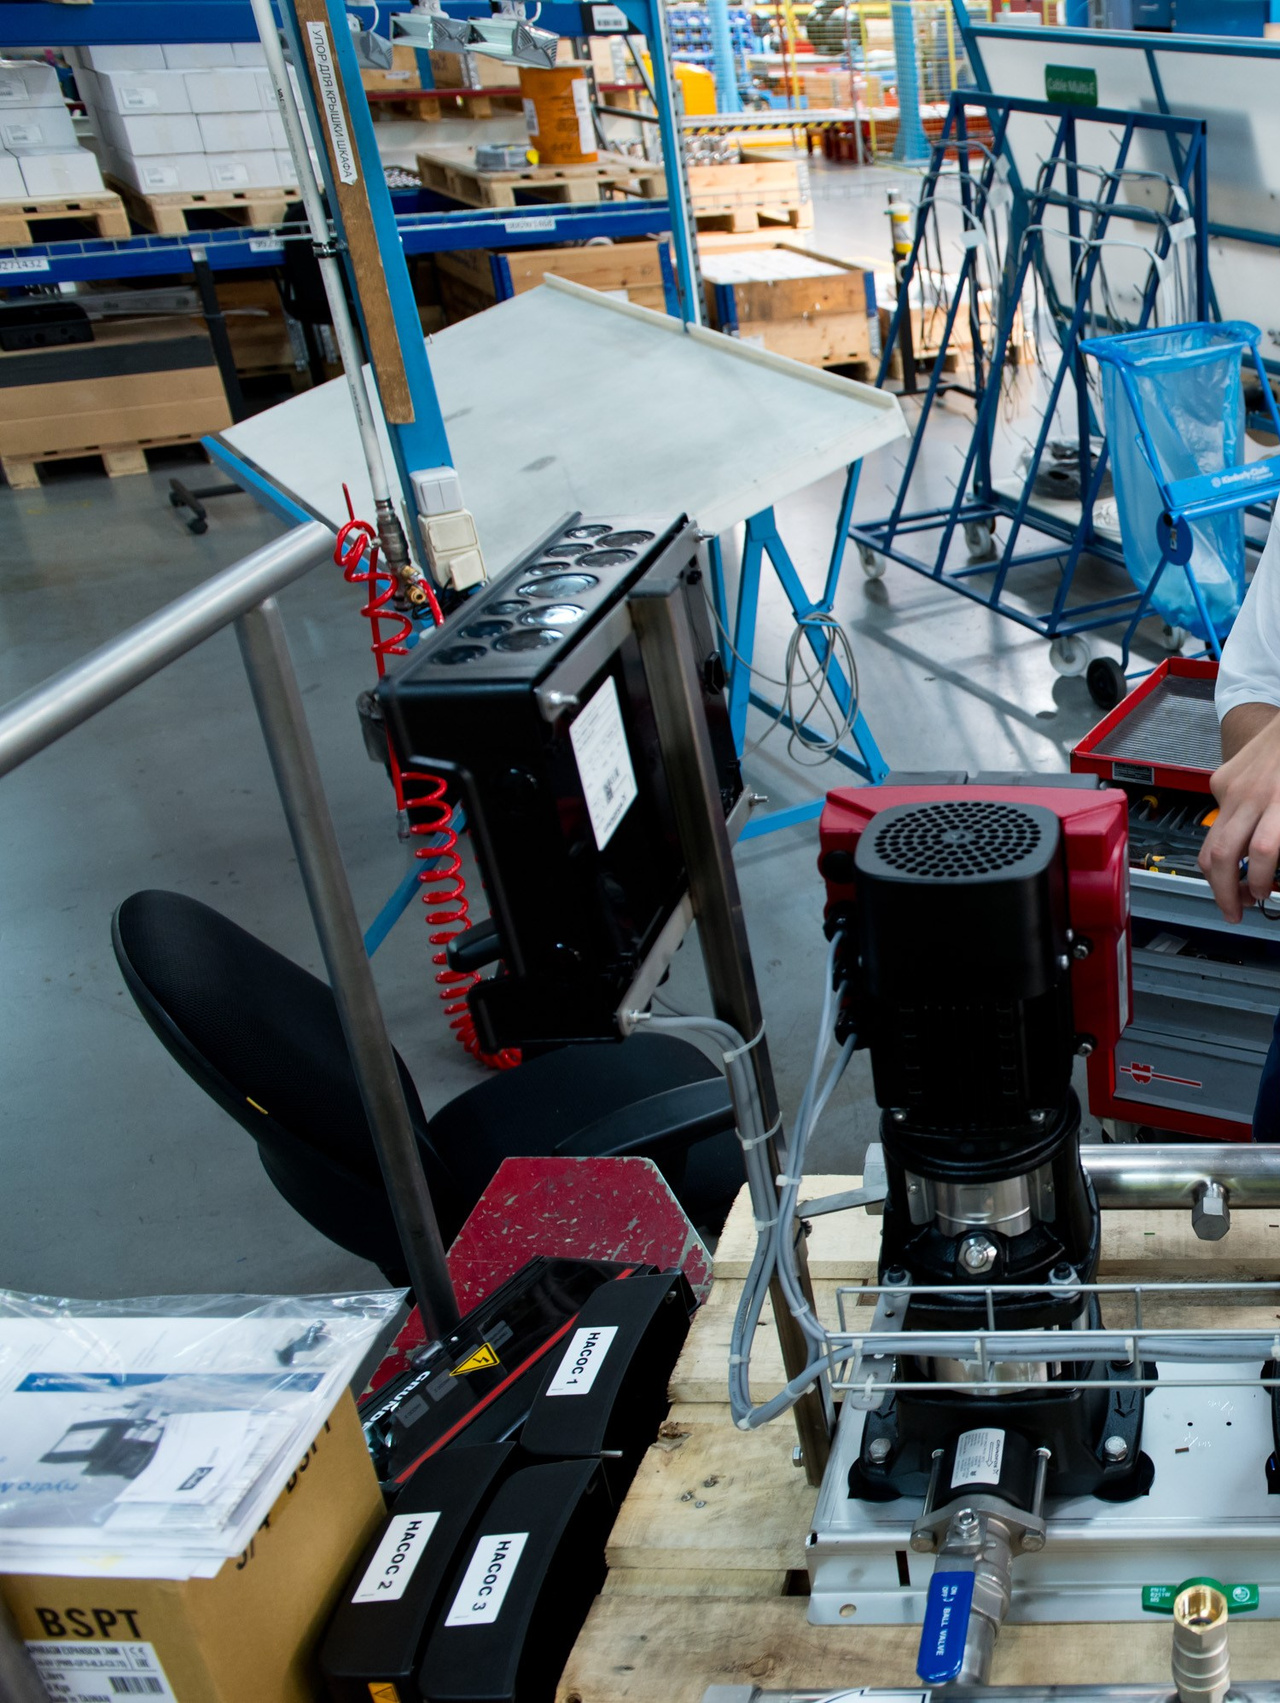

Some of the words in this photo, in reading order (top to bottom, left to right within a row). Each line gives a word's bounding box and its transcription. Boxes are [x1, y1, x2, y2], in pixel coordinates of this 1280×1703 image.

[312, 30, 329, 61] УПОР
[318, 63, 334, 88] ДЛЯ
[325, 89, 344, 137] КРЫШКИ
[336, 141, 353, 177] ШКАФА
[571, 1332, 601, 1375] НАСОС
[385, 1520, 422, 1576] НАСОС
[478, 1540, 512, 1597] НАСОС
[377, 1580, 393, 1590] 2
[36, 1607, 142, 1638] BSPT
[472, 1602, 486, 1612] 3
[940, 1607, 951, 1628] BALL
[935, 1629, 948, 1656] VALVE
